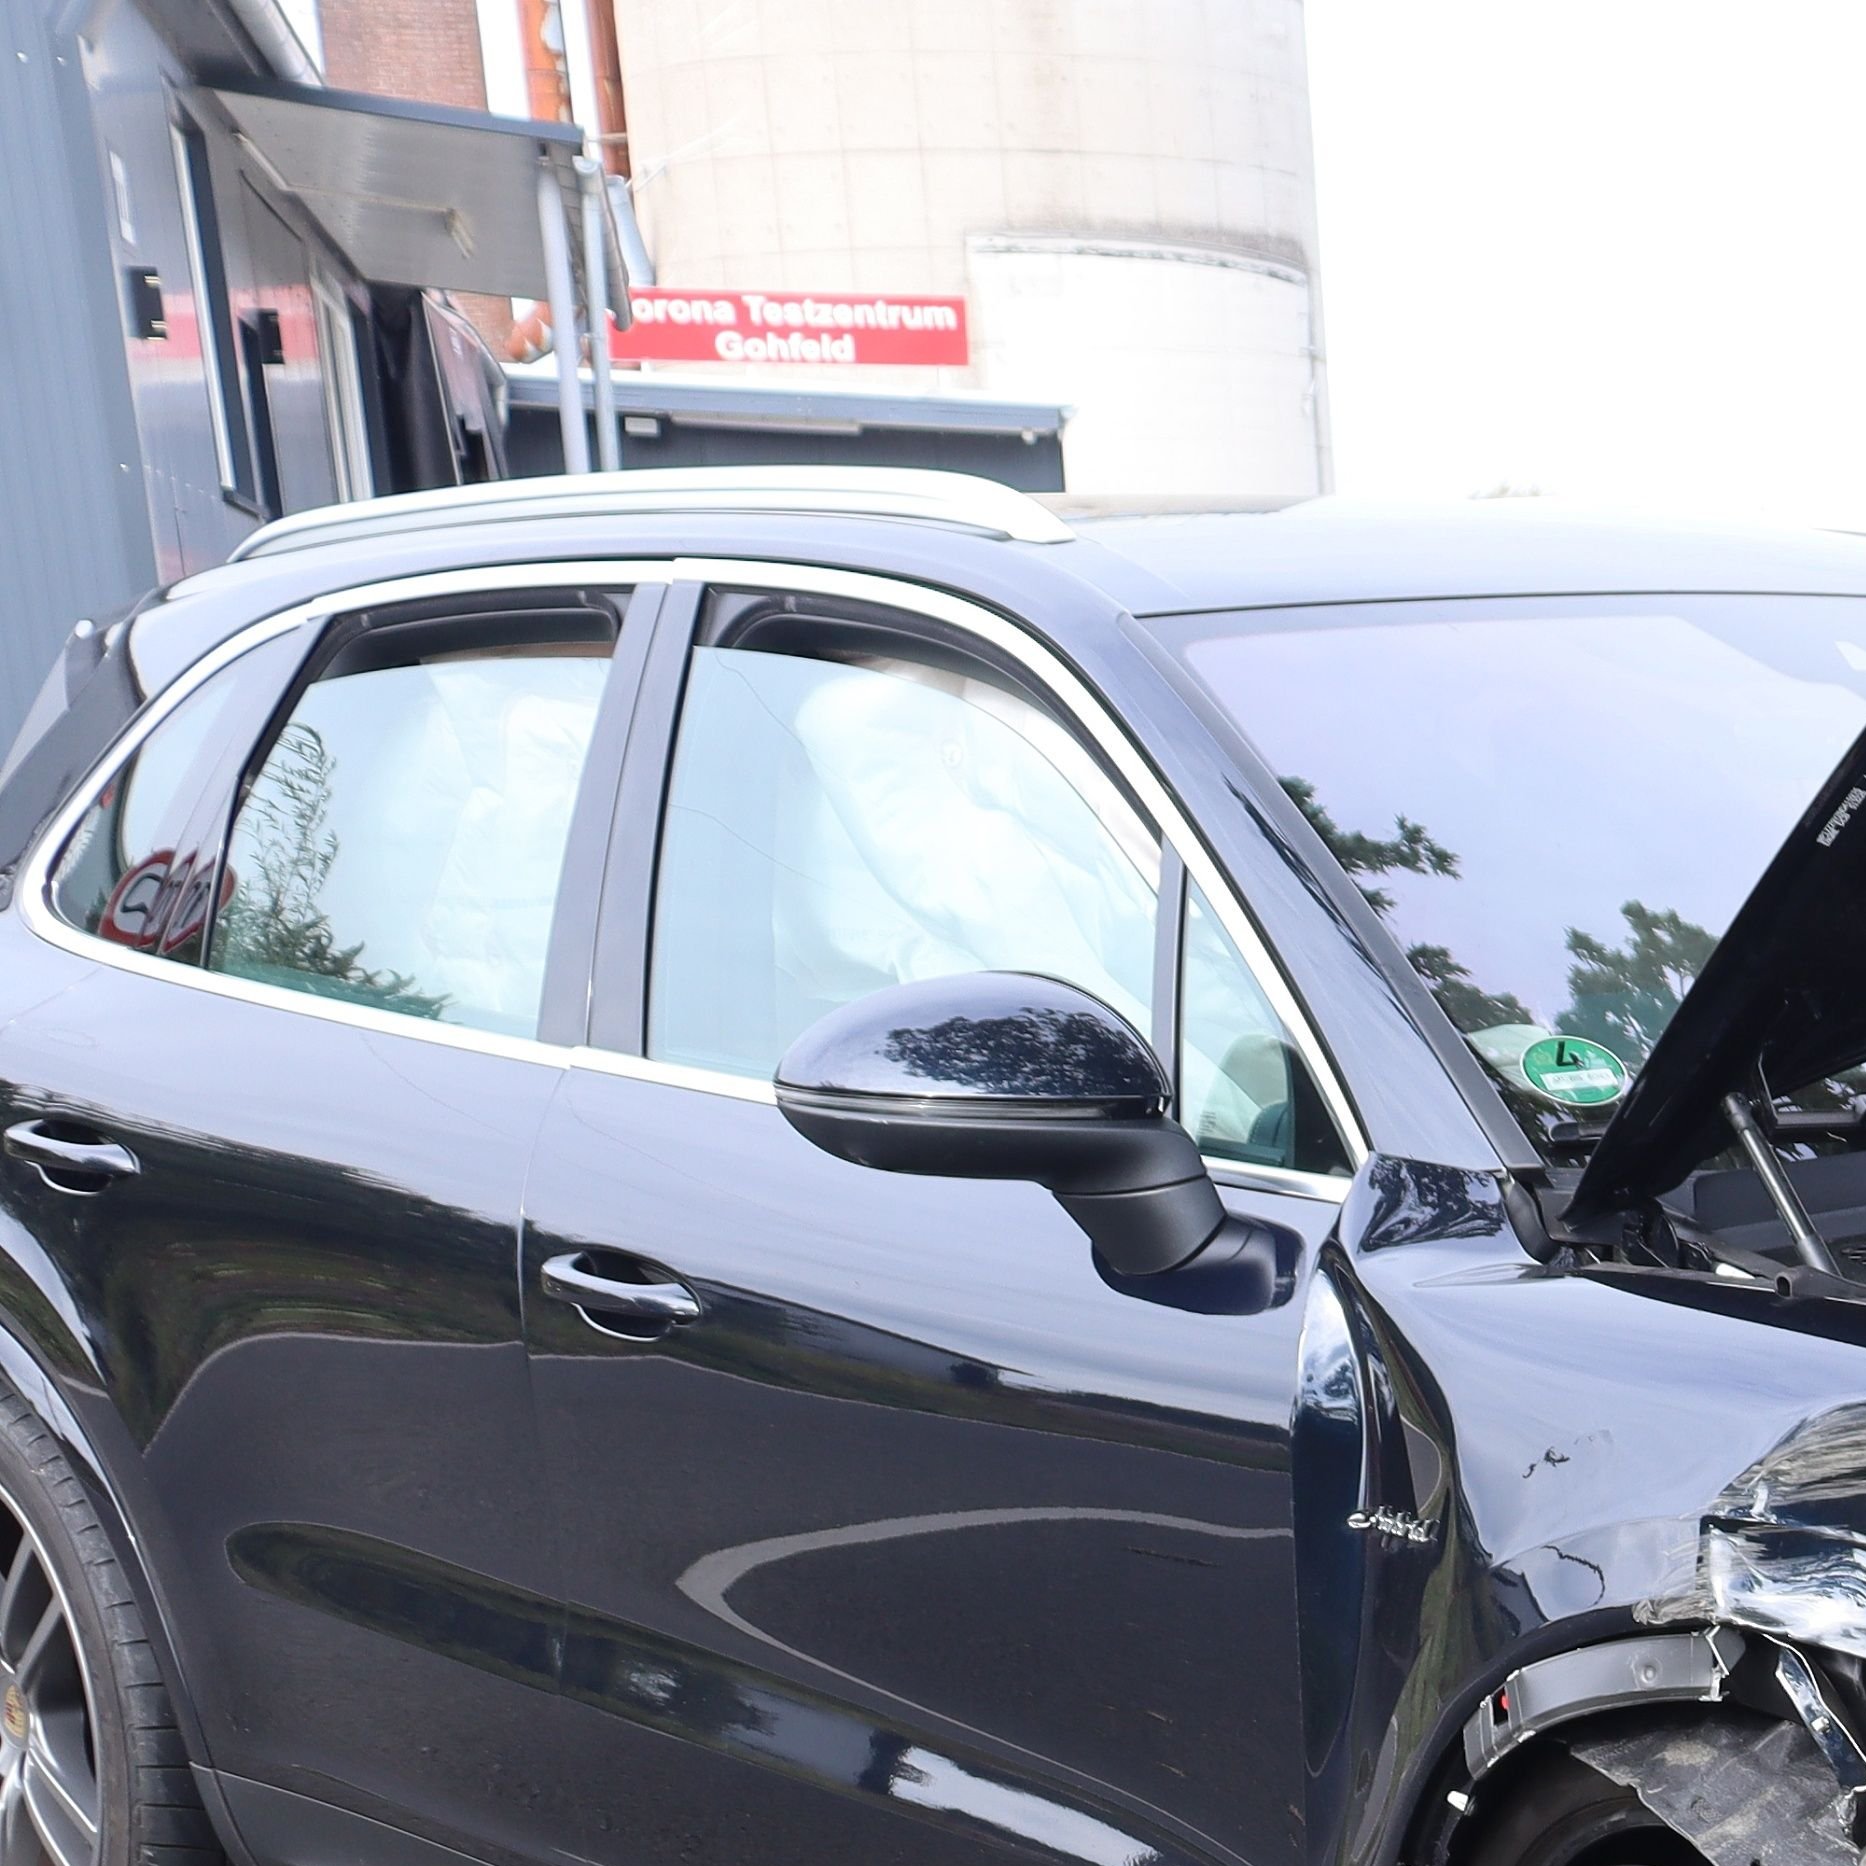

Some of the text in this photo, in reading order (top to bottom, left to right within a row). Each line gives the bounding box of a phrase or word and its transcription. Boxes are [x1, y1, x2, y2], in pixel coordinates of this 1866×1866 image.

[606, 295, 958, 331] orona Testzentrum
[713, 329, 857, 363] Gohfeld
